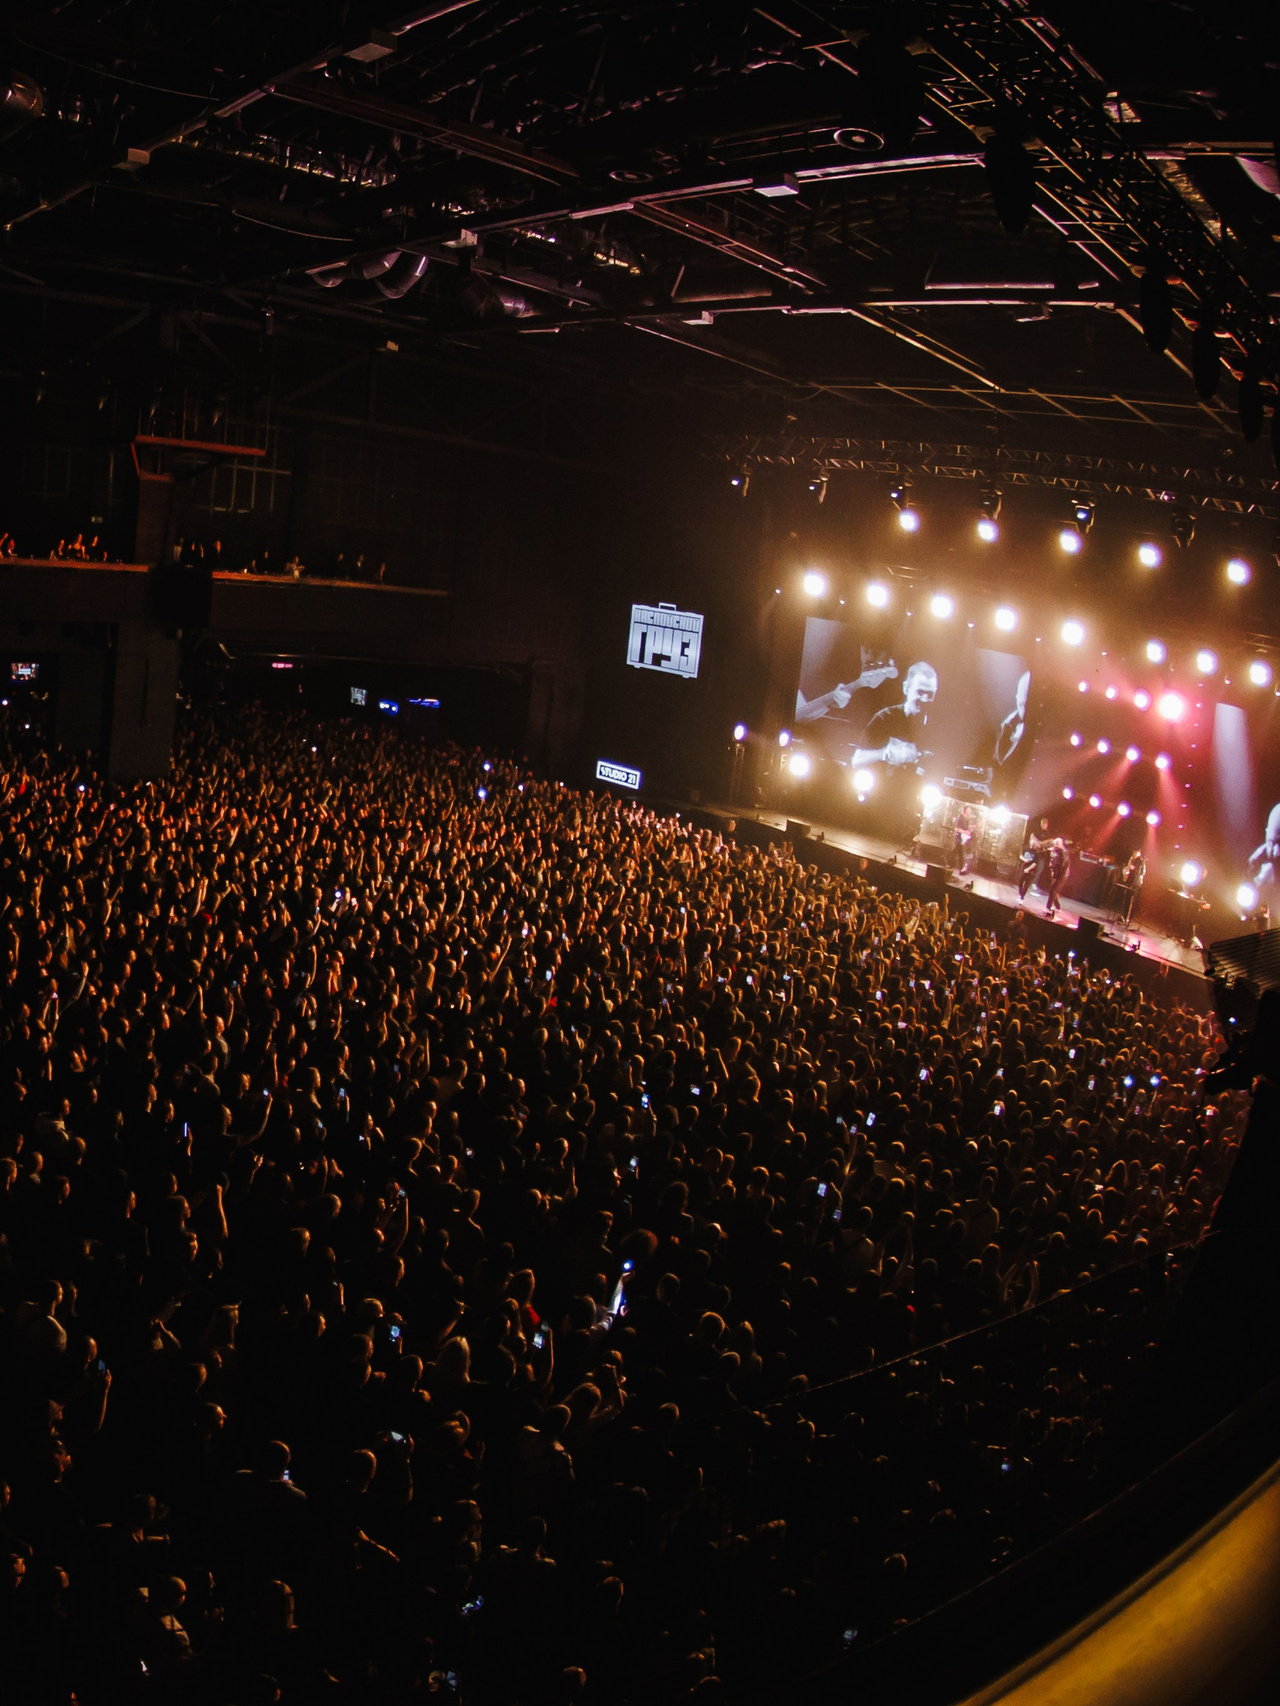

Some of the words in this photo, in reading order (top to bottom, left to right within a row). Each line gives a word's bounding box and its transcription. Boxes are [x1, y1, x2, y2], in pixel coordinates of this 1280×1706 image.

[631, 623, 699, 674] ГРУЗ
[600, 766, 627, 782] STUDIO
[628, 774, 636, 784] 21
